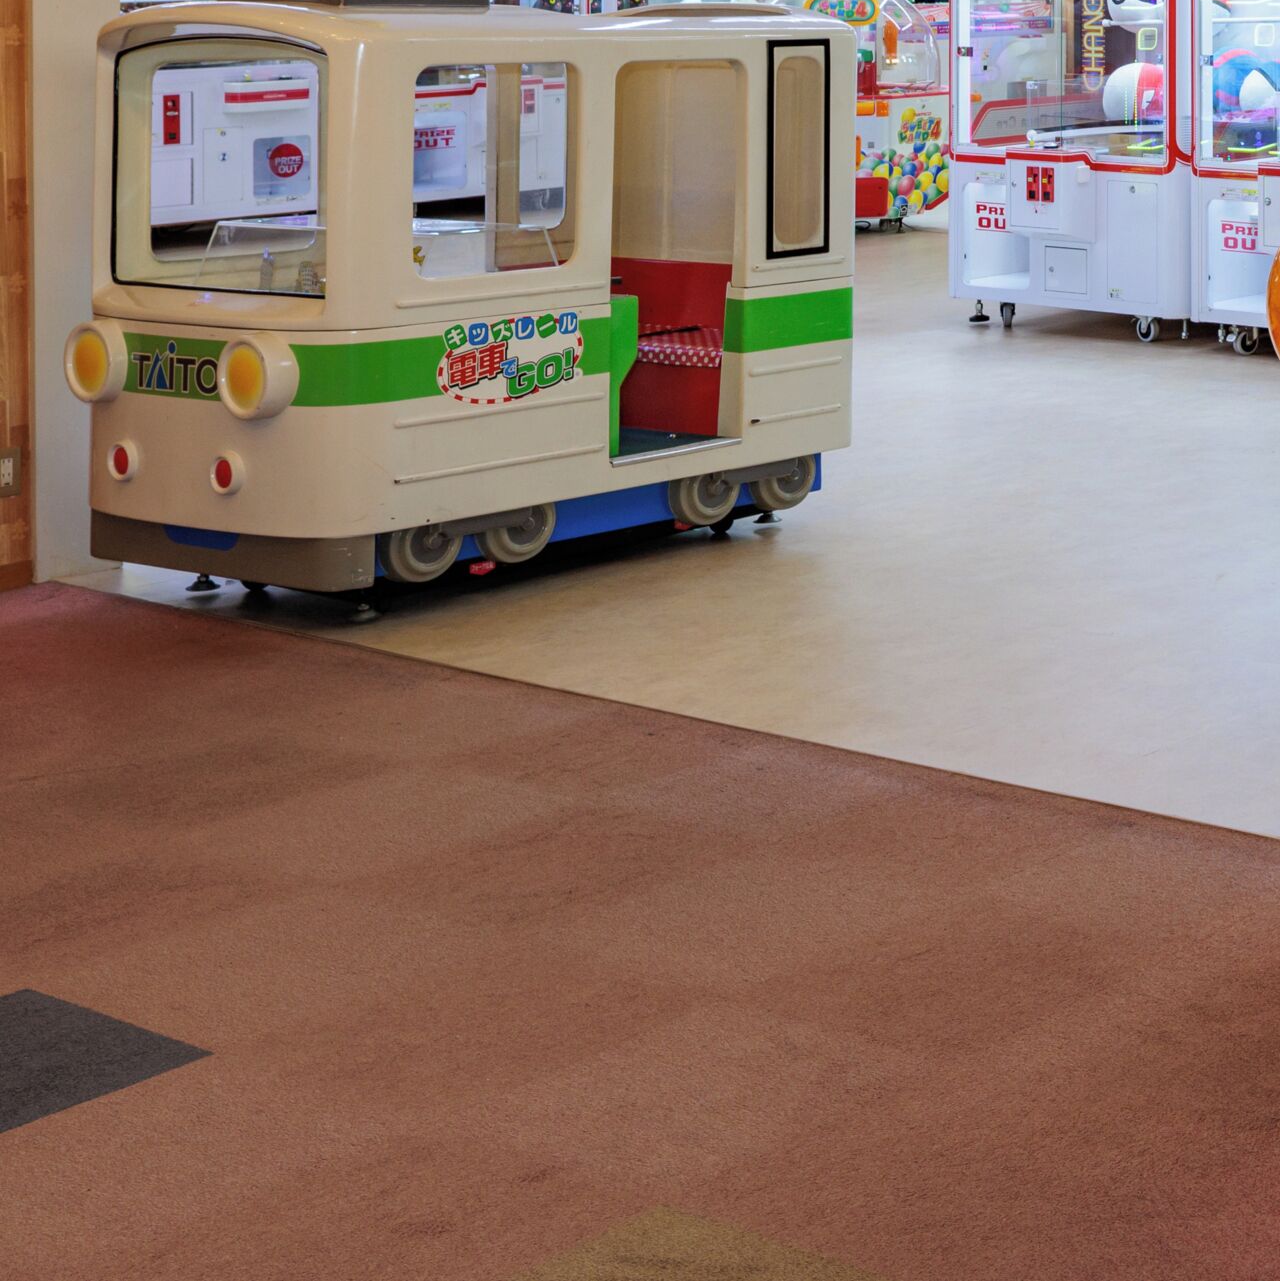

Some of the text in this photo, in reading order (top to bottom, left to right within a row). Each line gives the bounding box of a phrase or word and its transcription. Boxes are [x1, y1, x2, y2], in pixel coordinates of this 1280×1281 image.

[856, 0, 869, 19] 4
[900, 117, 936, 134] SWEET
[930, 117, 943, 141] 4
[275, 155, 302, 167] PRIZE
[278, 164, 299, 174] OUT
[976, 204, 1005, 216] PRI
[978, 216, 1006, 230] OU
[1221, 223, 1258, 237] PRI
[1223, 236, 1257, 251] OU
[445, 313, 577, 348] キッズレール
